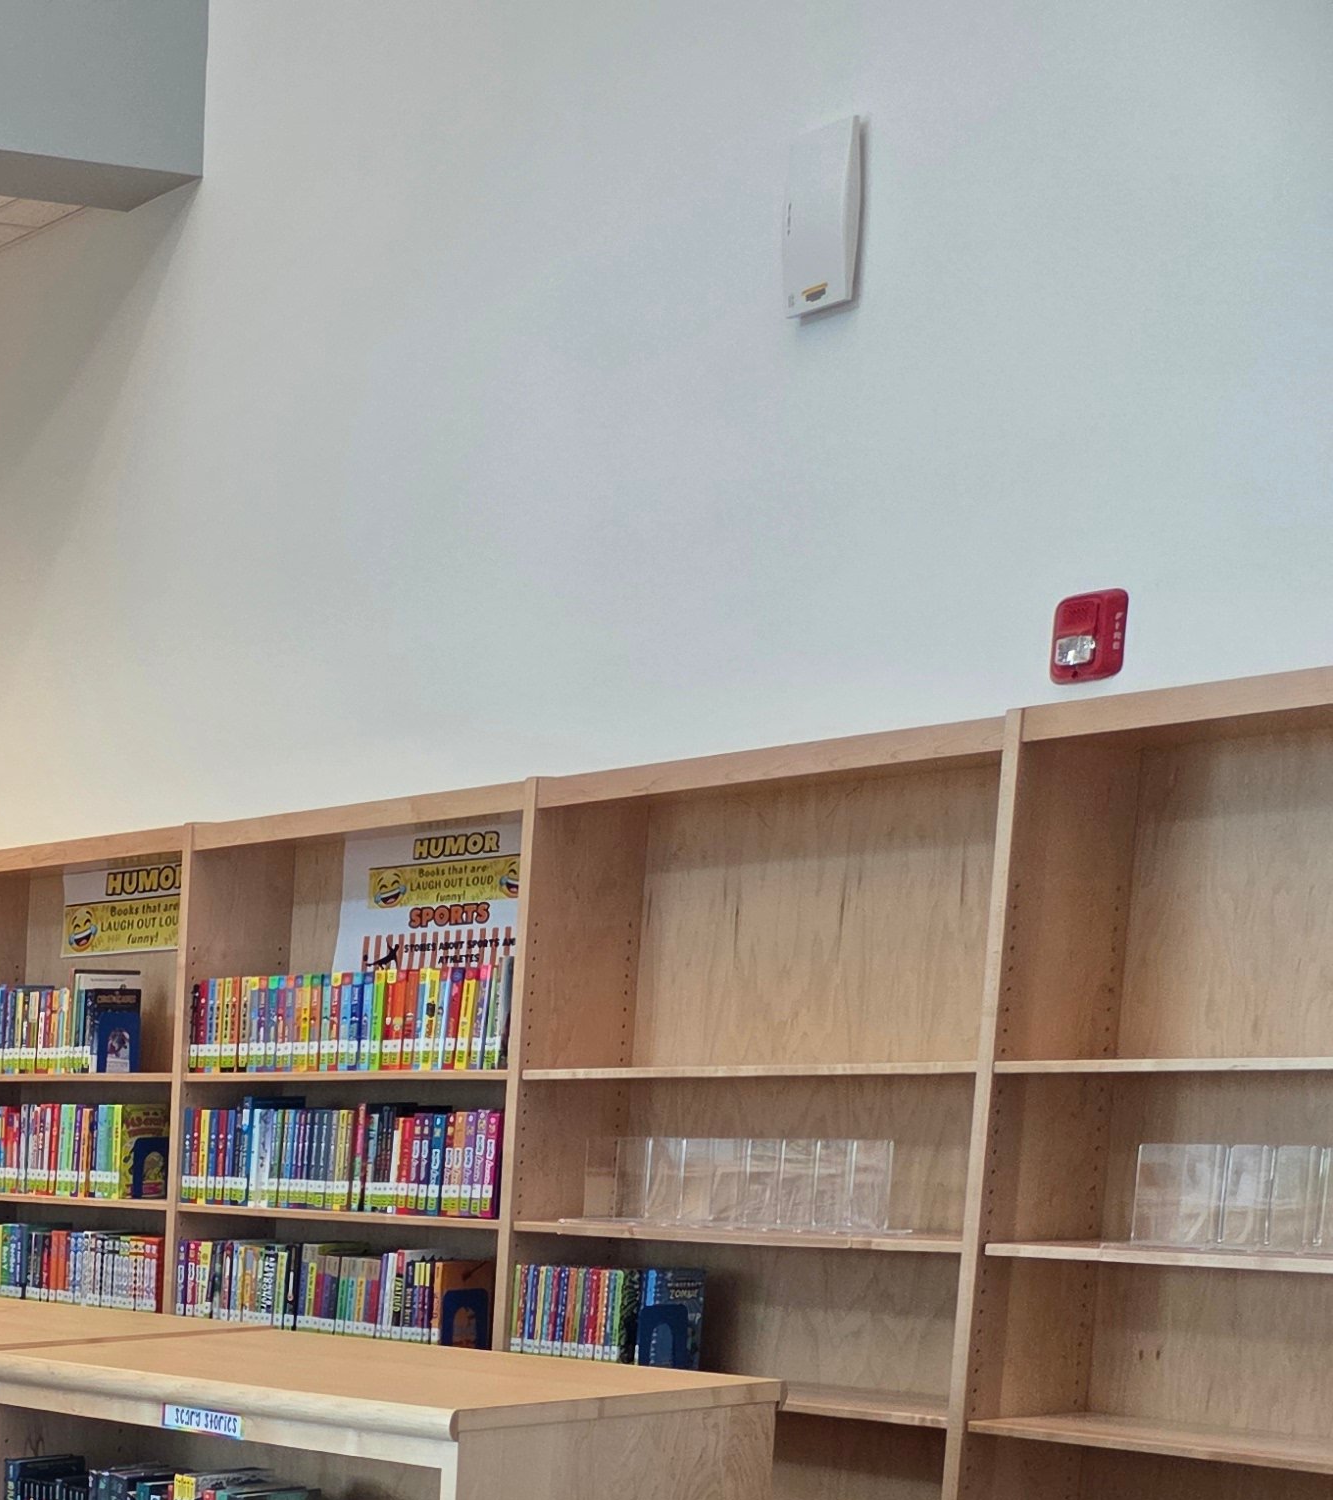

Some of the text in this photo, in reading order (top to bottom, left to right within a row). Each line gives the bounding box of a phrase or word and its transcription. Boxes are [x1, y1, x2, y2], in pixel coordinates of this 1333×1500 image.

[1112, 611, 1124, 650] FIRE
[413, 831, 500, 860] HUMOR
[418, 864, 487, 878] Books that are
[409, 874, 494, 892] LAUGH OUT LOUD
[110, 902, 179, 917] Books that are
[408, 902, 490, 929] SPORTS
[100, 916, 179, 932] LAUGH OUT LOU
[127, 932, 159, 946] funny!
[404, 937, 516, 953] STORIES ABOUT SPORTS AN
[437, 953, 480, 965] ATHLETES
[670, 1289, 699, 1299] ZOMBIE
